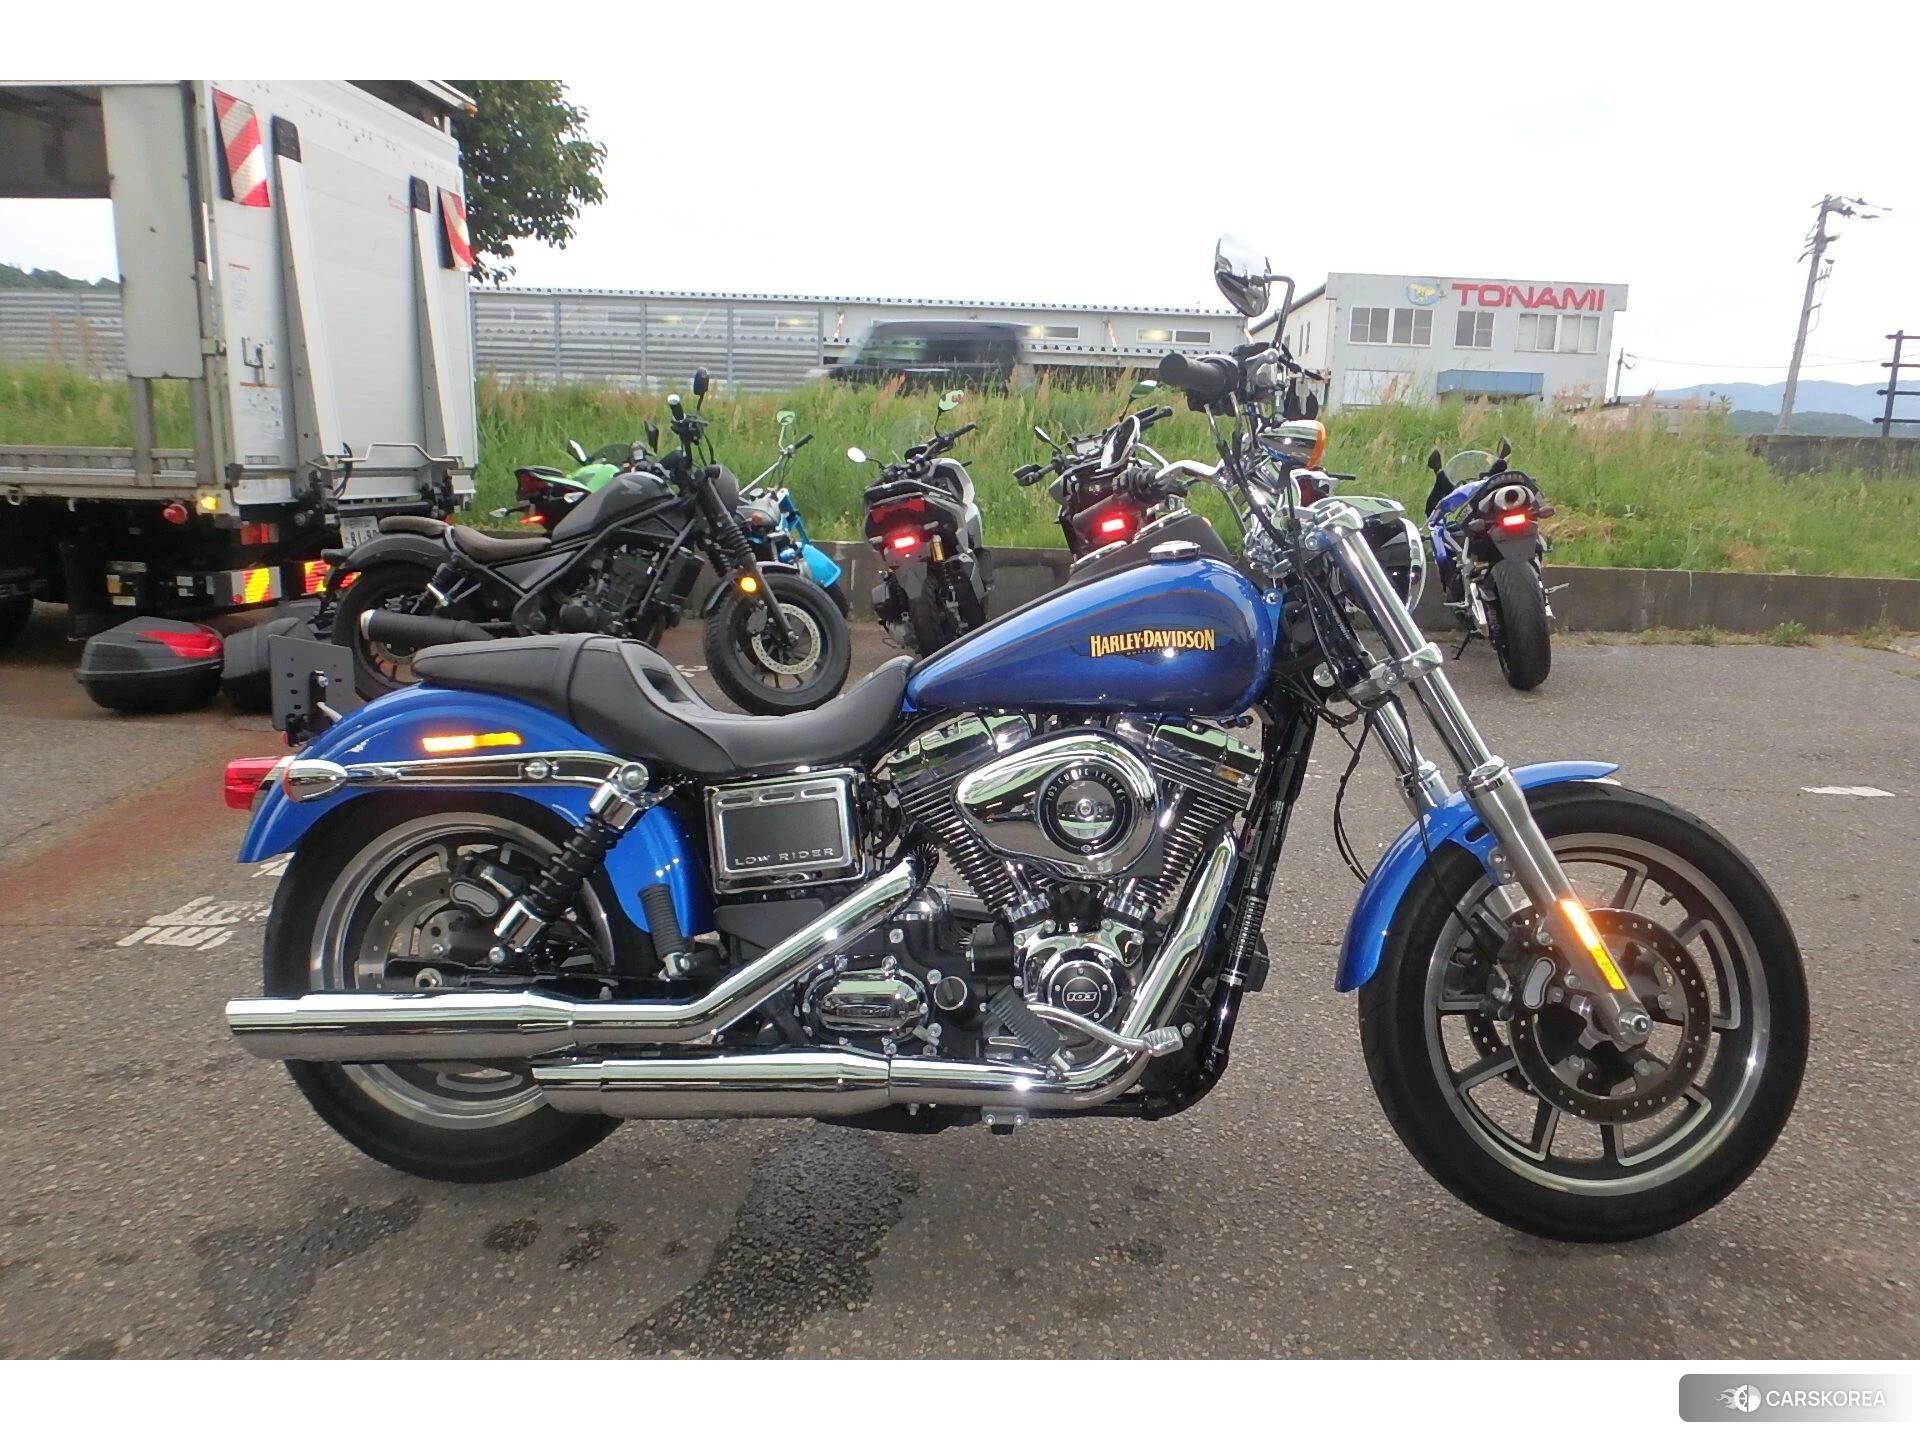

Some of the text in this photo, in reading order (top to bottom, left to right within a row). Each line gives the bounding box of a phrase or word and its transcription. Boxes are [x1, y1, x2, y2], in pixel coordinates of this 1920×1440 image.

[1452, 283, 1605, 311] TONAMI
[1057, 768, 1089, 785] CUIC
[734, 847, 834, 866] LOW RIDER
[1066, 991, 1098, 1002] 103
